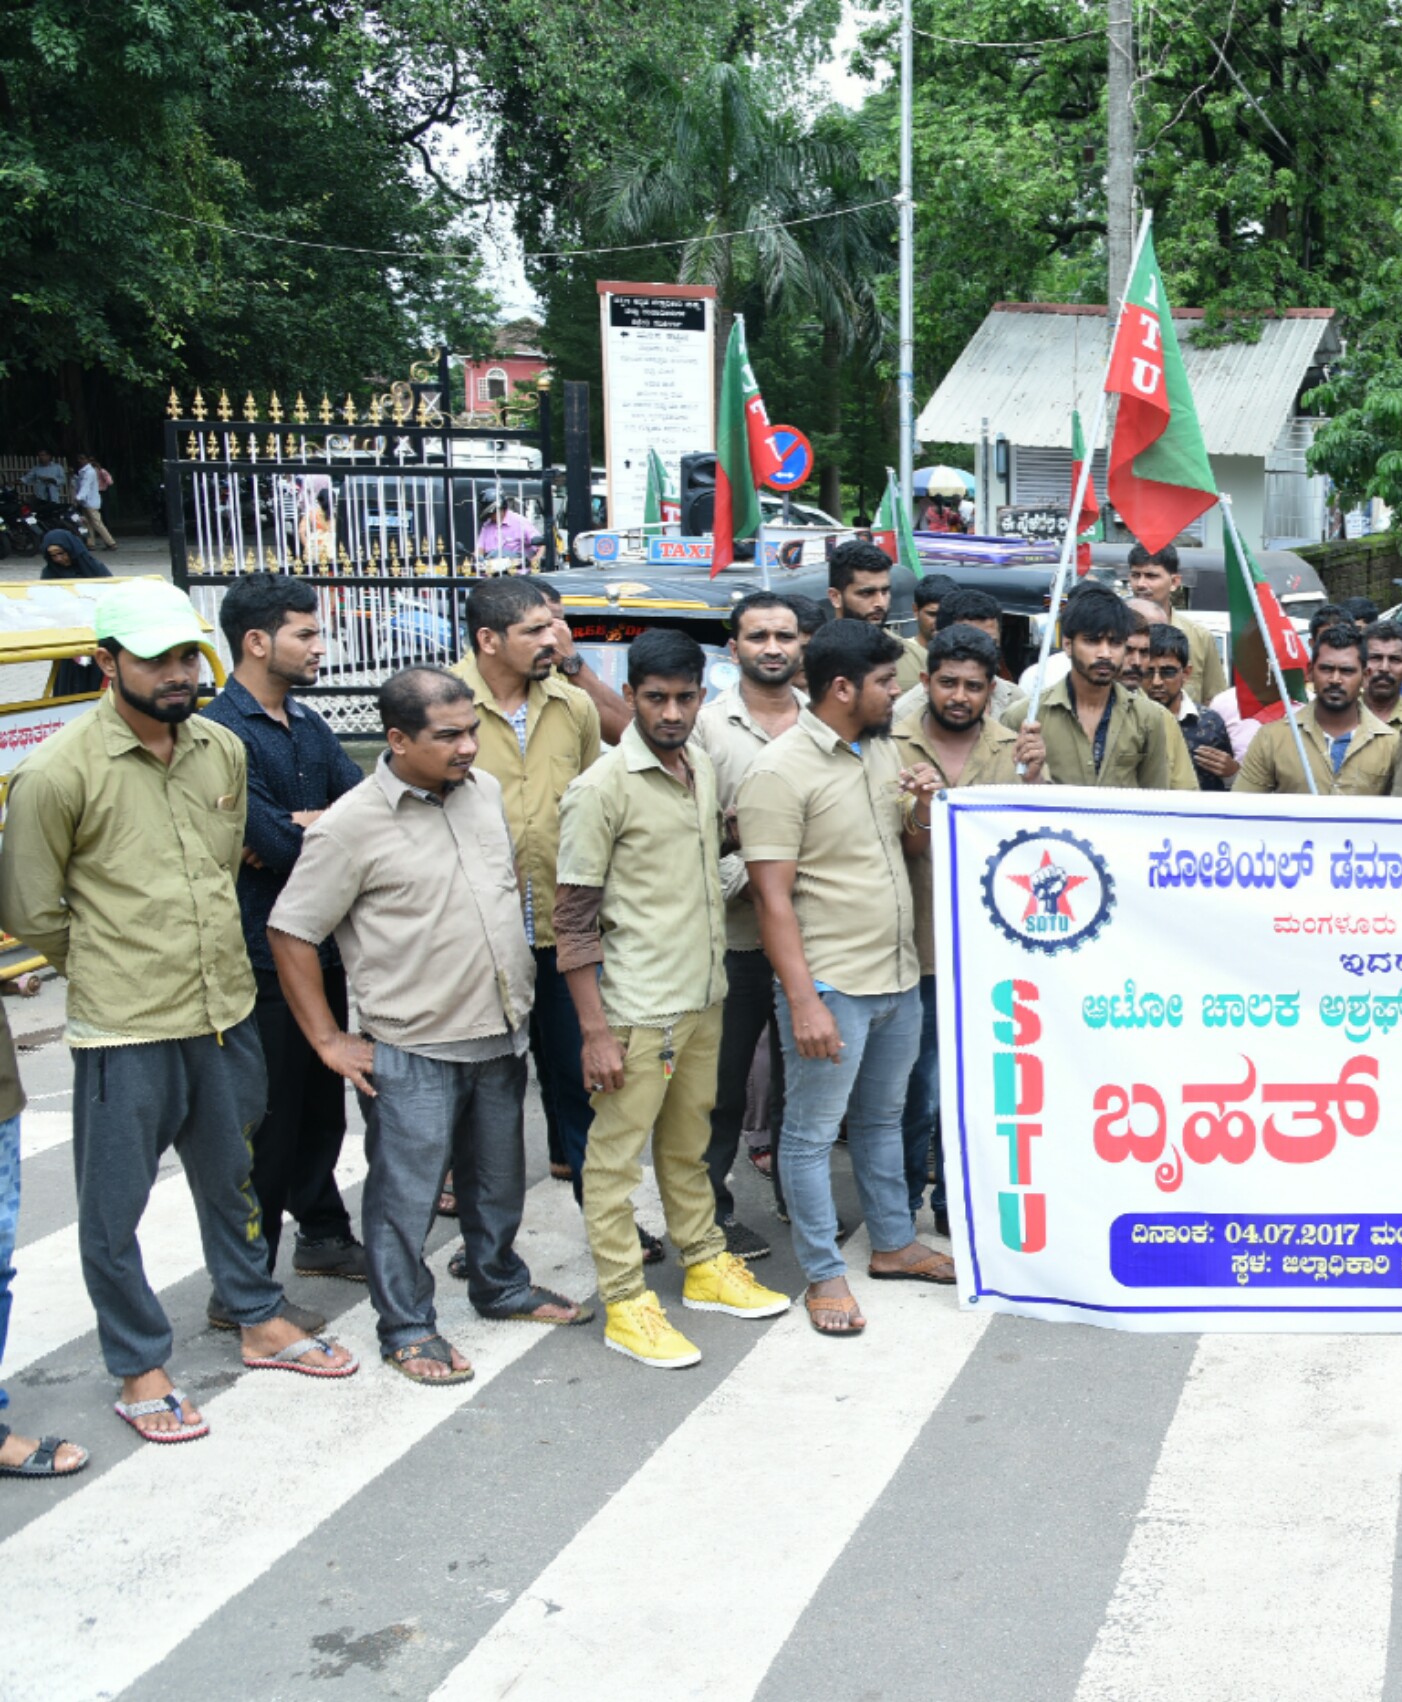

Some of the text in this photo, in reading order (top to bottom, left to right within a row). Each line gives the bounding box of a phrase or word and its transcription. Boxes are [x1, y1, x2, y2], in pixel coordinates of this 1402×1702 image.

[659, 543, 712, 558] TAXI
[1148, 839, 1314, 889] ಸೋಶಿಯಲ್
[1026, 915, 1069, 932] SDTU
[1082, 978, 1183, 1029] ಆಟೋ
[1202, 992, 1300, 1028] ಚಾಲಕ
[991, 979, 1046, 1253] SDTU
[1093, 1054, 1379, 1193] ಬೃಹತ್
[1132, 1221, 1214, 1243] ದಿನಾಂಕ:
[1225, 1222, 1360, 1245] 04.07.2017
